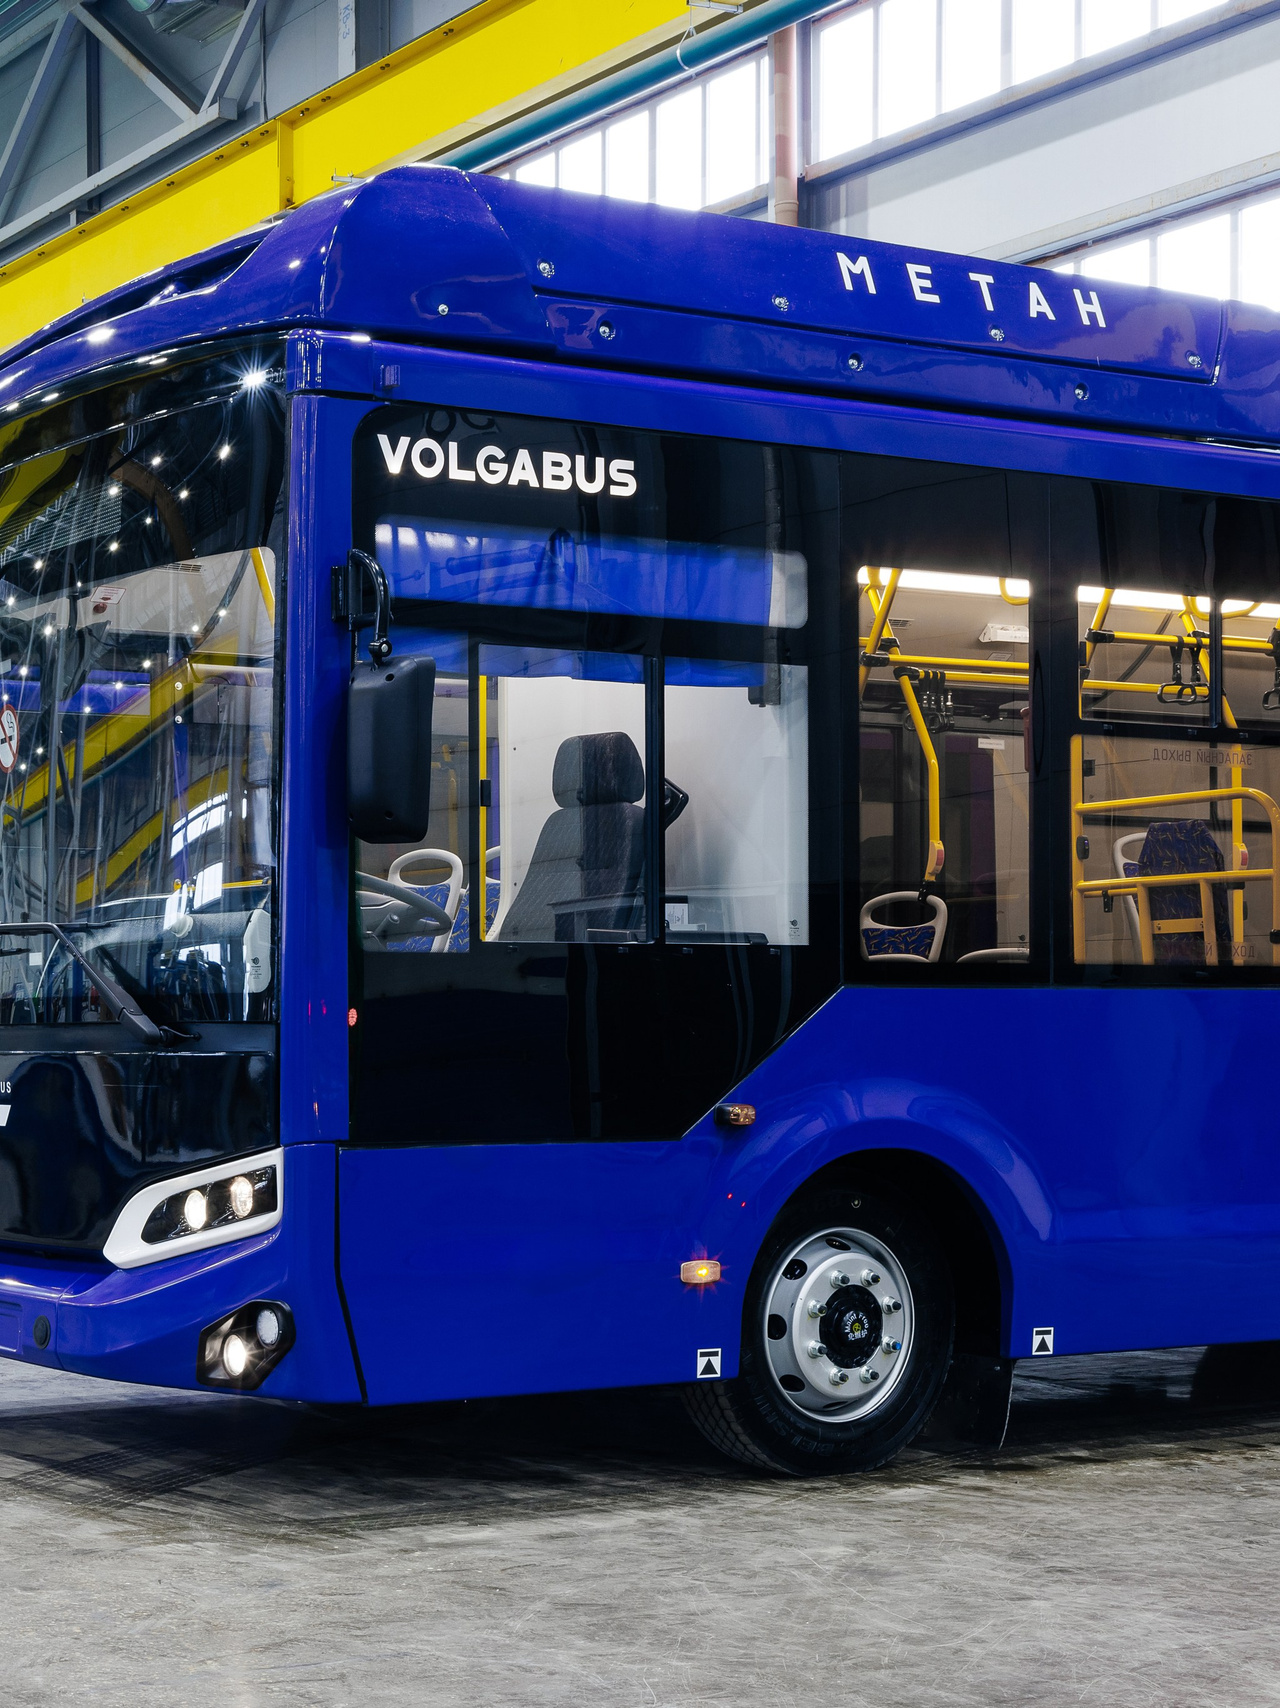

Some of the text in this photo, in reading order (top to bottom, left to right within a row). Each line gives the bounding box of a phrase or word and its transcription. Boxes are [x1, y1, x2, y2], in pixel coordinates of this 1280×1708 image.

[835, 251, 1107, 329] МЕТАН
[377, 433, 638, 497] VOLGABUS
[858, 1312, 870, 1329] Free
